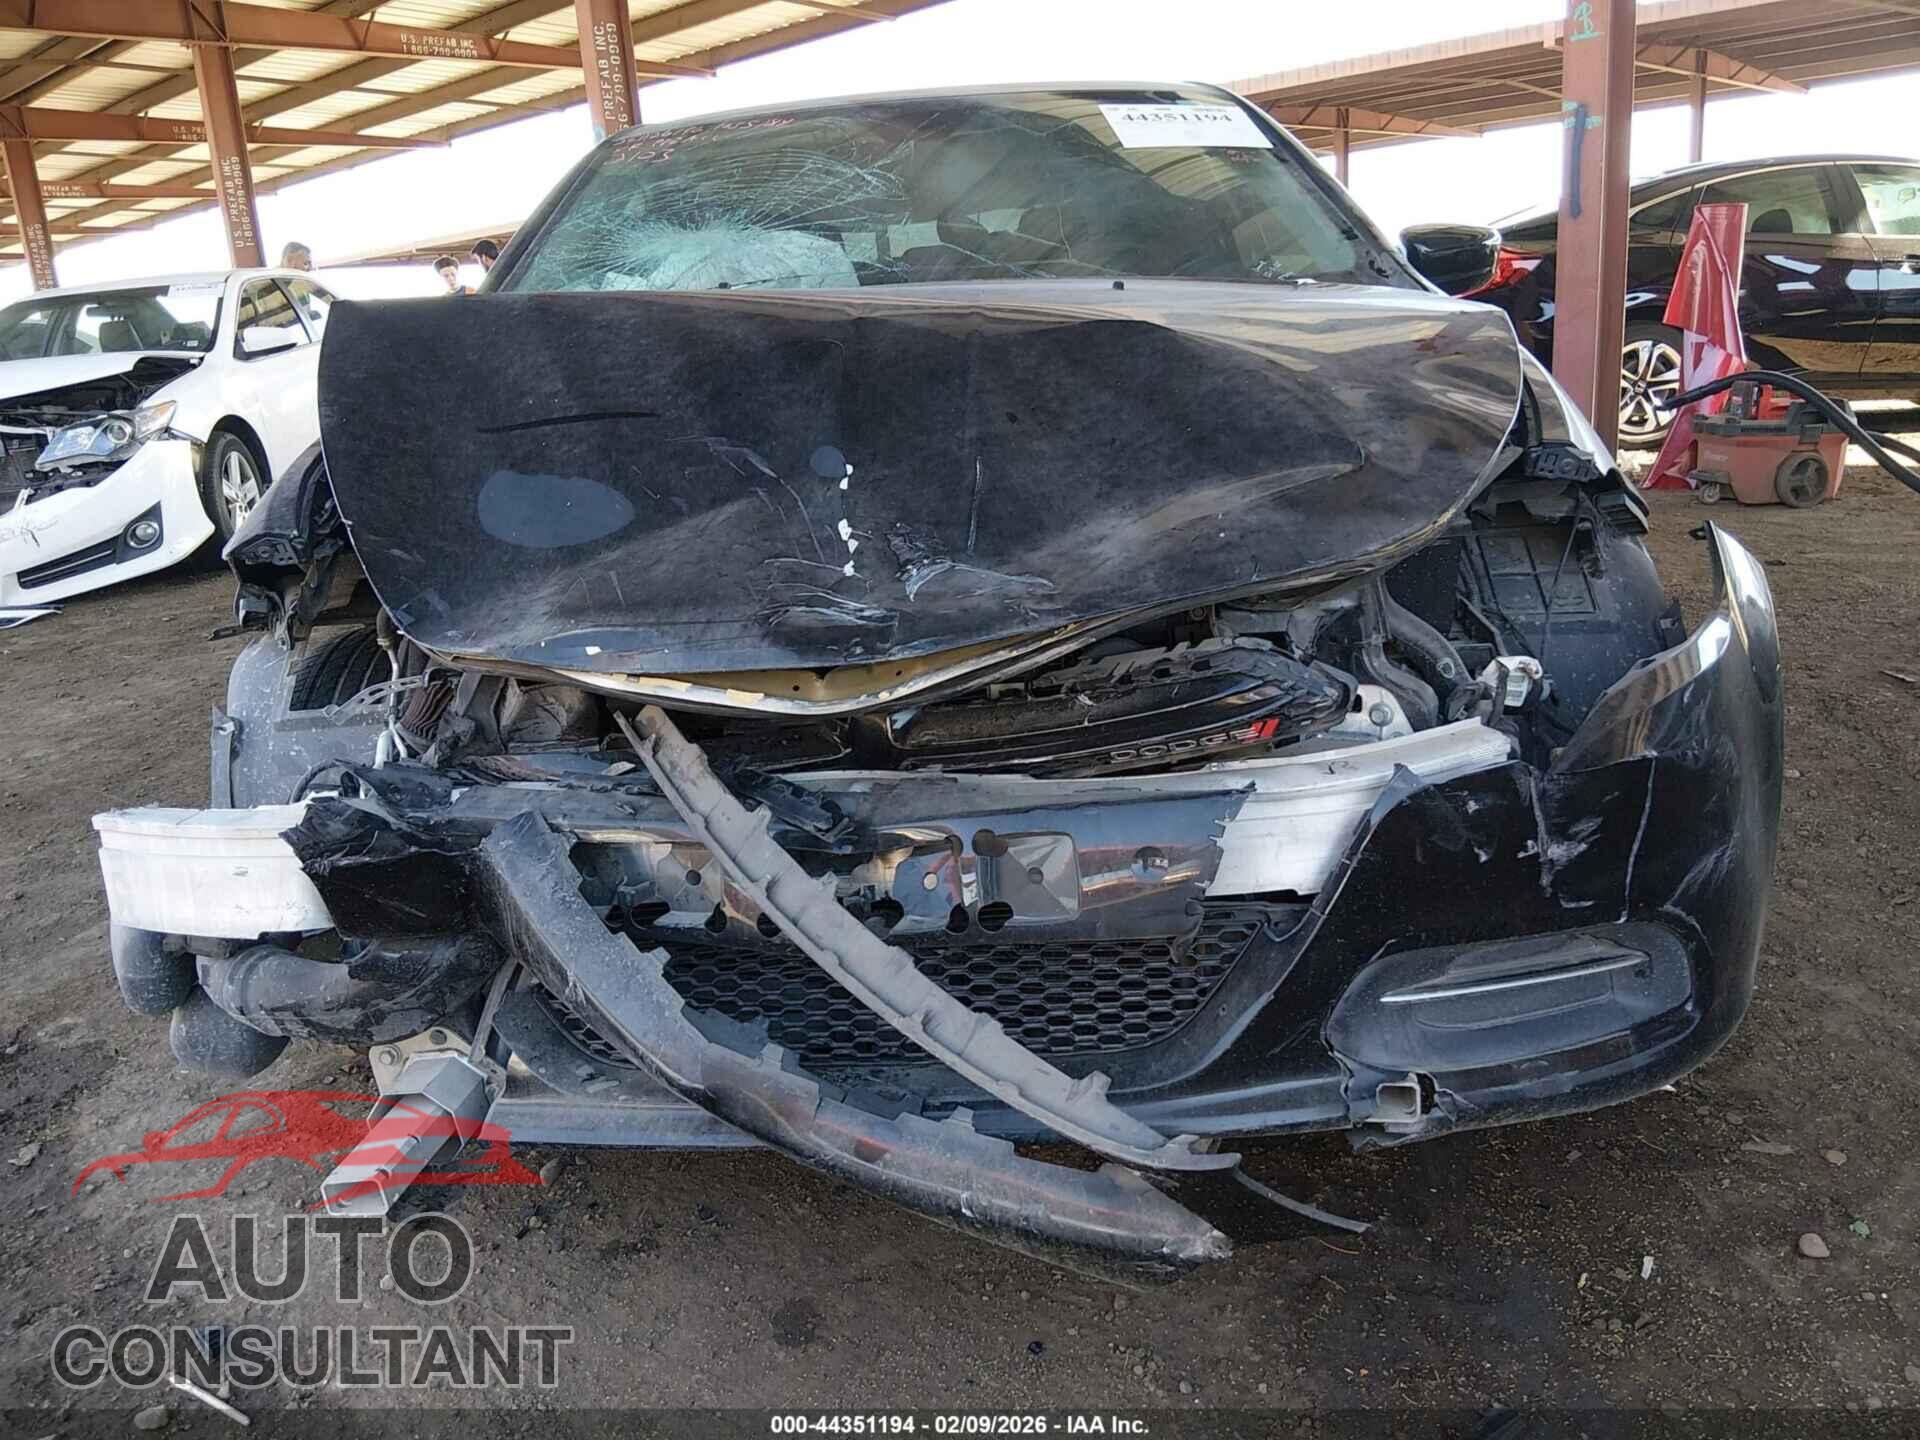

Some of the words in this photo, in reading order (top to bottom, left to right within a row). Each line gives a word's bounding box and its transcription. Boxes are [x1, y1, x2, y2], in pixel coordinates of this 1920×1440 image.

[423, 35, 457, 48] PREFAB
[594, 20, 607, 51] INC.
[598, 59, 617, 120] PREFAB
[1121, 112, 1233, 123] 44351194
[224, 181, 241, 222] PREFAB
[1110, 727, 1260, 764] DODGE
